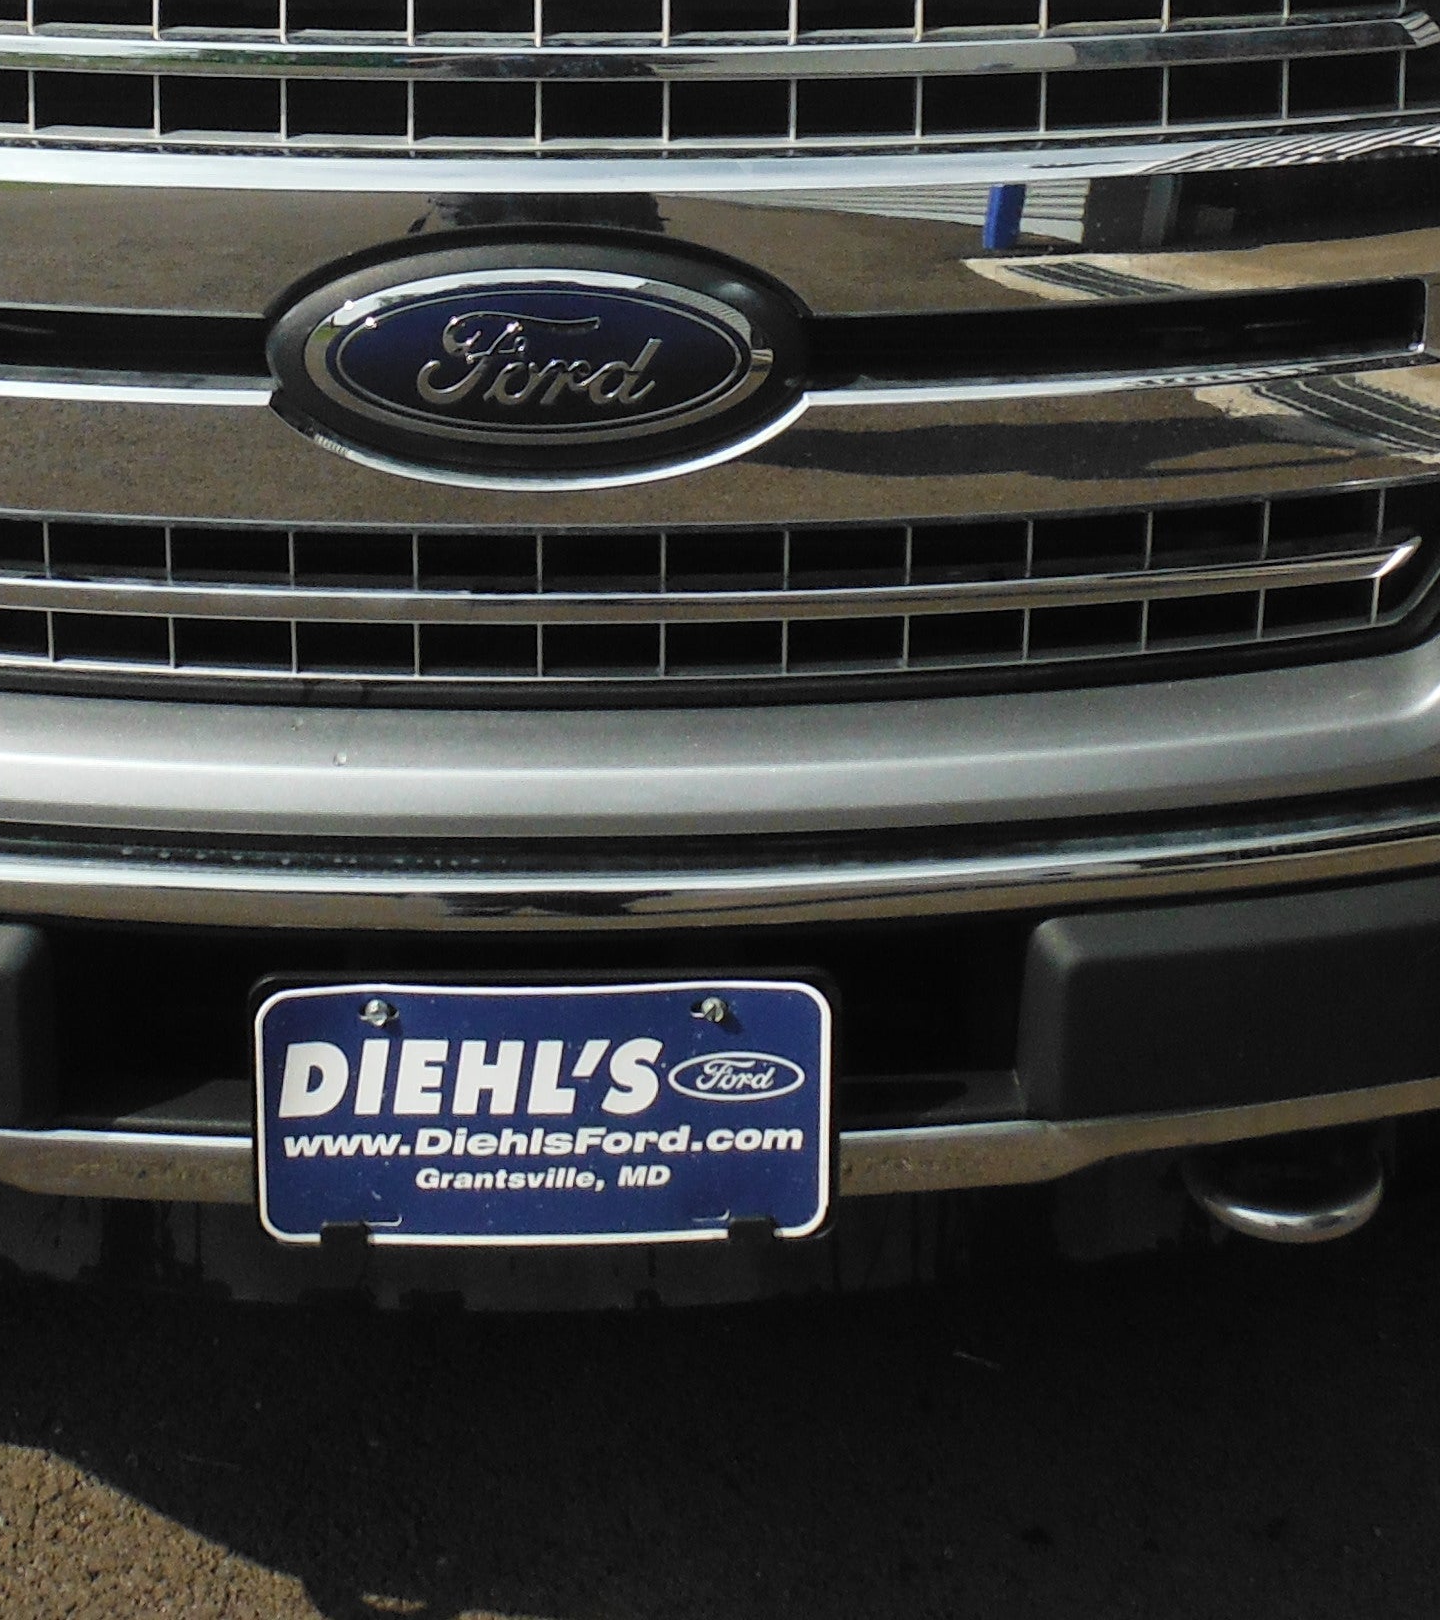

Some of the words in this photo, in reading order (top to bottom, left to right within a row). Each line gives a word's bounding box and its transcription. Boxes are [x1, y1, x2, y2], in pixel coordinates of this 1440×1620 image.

[417, 311, 663, 405] Ford
[278, 1037, 663, 1118] DIEHL'S
[695, 1060, 774, 1090] Ford
[283, 1125, 803, 1157] www.DiehlsFord.com
[415, 1167, 605, 1191] Grantsville,
[617, 1165, 671, 1187] MD
